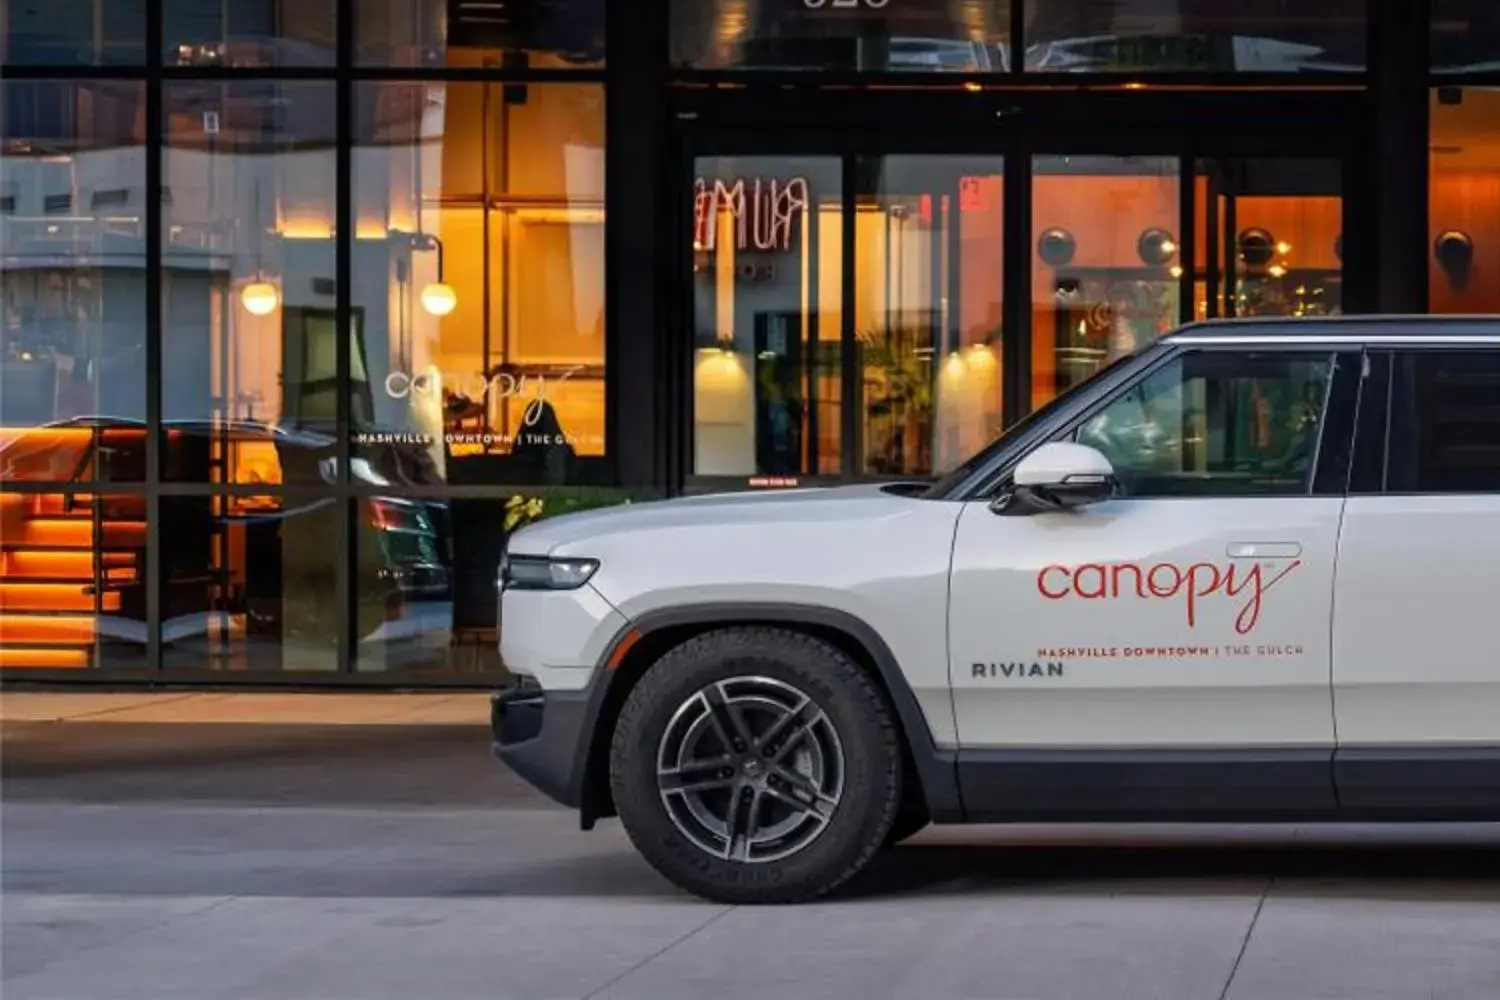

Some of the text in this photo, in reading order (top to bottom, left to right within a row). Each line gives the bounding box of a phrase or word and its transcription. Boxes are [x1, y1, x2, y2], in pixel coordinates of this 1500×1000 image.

[358, 433, 430, 444] NASHVILLE
[527, 433, 550, 444] THE
[1037, 560, 1300, 634] canopy
[1037, 647, 1117, 658] NASHVILLE
[1123, 647, 1209, 657] DOWNTOWN
[1224, 645, 1250, 657] THE
[1257, 644, 1303, 656] GULCH
[972, 662, 1063, 678] RIVIAN
